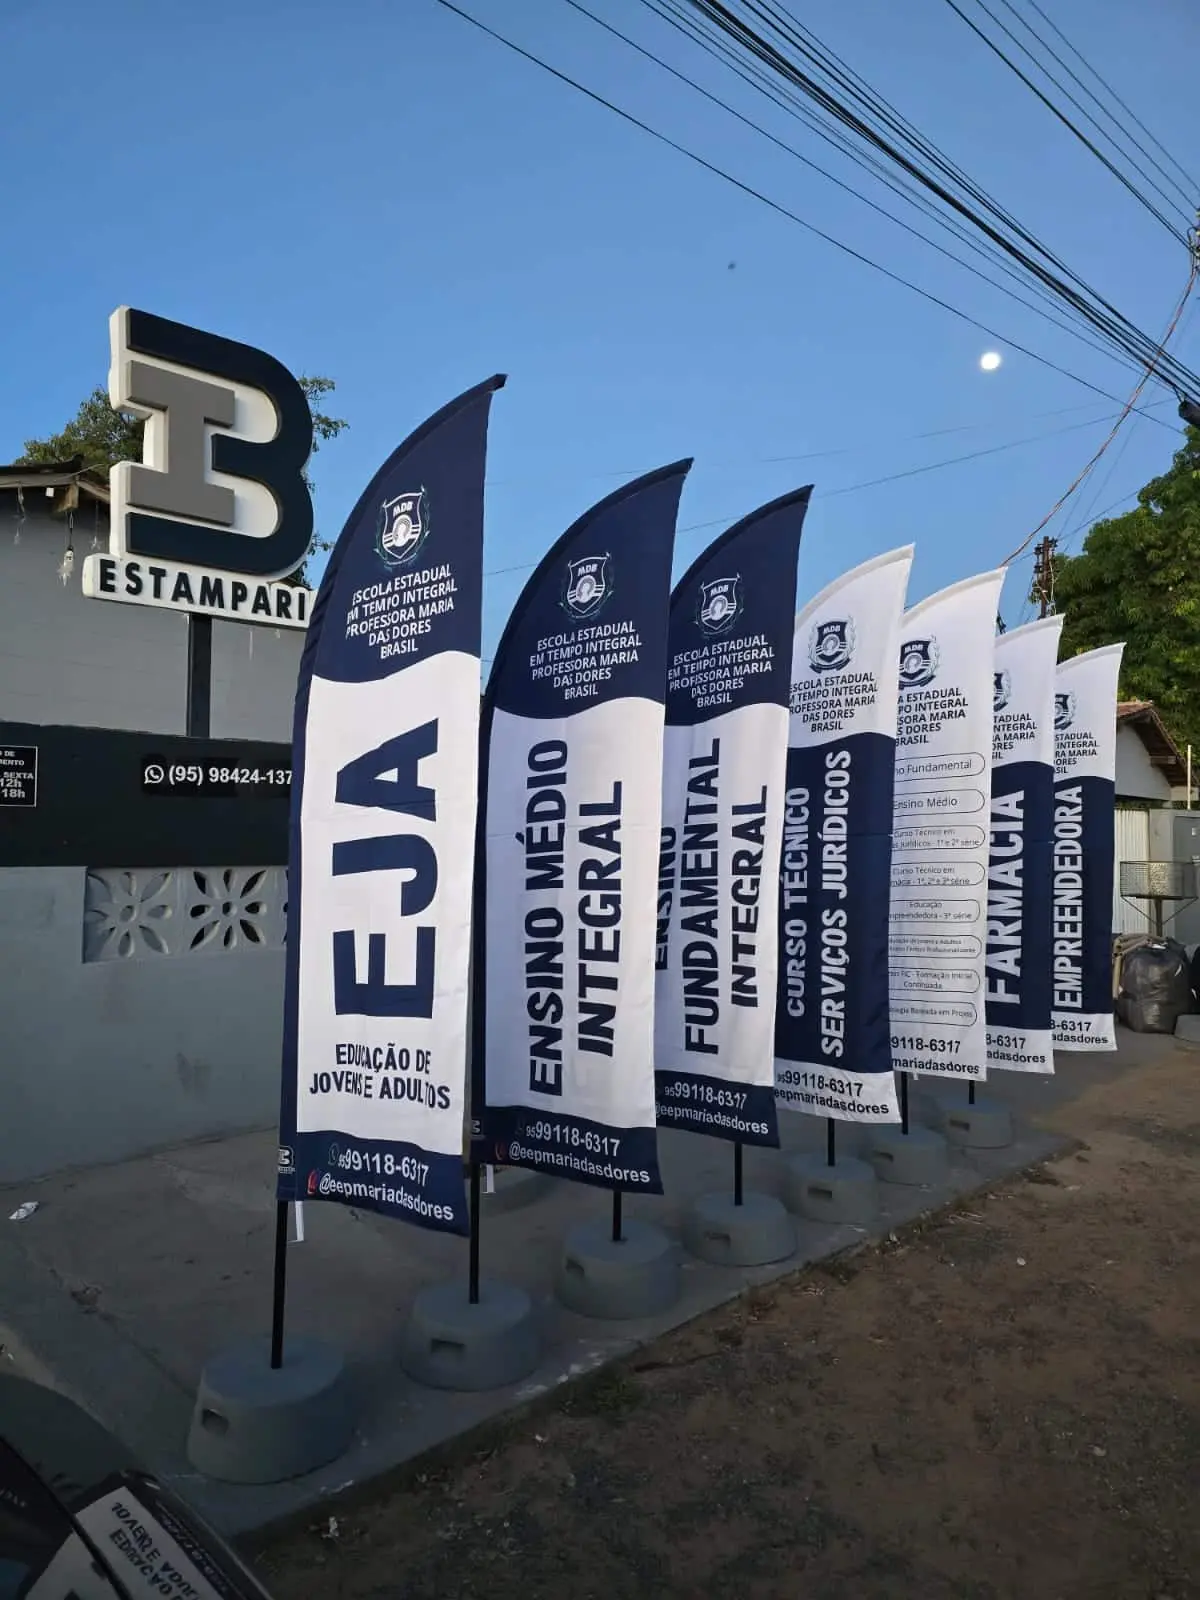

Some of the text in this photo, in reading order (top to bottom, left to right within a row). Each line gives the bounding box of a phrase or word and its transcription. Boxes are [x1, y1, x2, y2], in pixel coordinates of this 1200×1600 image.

[394, 564, 452, 591] ESTADUAL
[402, 578, 458, 604] INTEGRAL
[419, 596, 455, 619] MARIA
[392, 620, 431, 639] DORES
[537, 620, 636, 652] ESCOLA ESTADUAL
[380, 640, 418, 660] BRASIL
[529, 634, 642, 667] EM TEMPO INTEGRAL
[673, 634, 768, 666] ESCOLA ESTADUAL
[718, 647, 775, 666] INTEGRAL
[532, 649, 639, 681] PROFESSORA MARIA
[733, 661, 772, 677] MARIA
[553, 667, 612, 688] DAS DORES
[824, 672, 875, 686] ESTADUAL
[564, 683, 599, 700] BRASIL
[691, 677, 744, 699] DAS DORES
[797, 689, 829, 702] TEMPO
[831, 682, 879, 696] INTEGRAL
[906, 687, 962, 703] ESTADUAL
[697, 692, 733, 708] BRASIL
[844, 695, 876, 708] MARIA
[914, 697, 969, 713] INTEGRAL
[802, 708, 855, 723] DAS DORES
[929, 708, 966, 721] MARIA
[811, 720, 844, 732] BRASIL
[905, 722, 942, 735] DORES
[1003, 731, 1036, 742] MARIA
[1057, 740, 1099, 750] INTEGRAL
[1068, 748, 1097, 757] MARIA
[3, 772, 34, 780] SEXTA
[168, 765, 202, 786] (95)
[907, 759, 972, 774] Fundamental
[2, 788, 25, 798] 18h
[927, 797, 958, 808] Médio
[332, 718, 439, 1019] EJA
[680, 737, 720, 1055] FUNDAMENTAL
[731, 785, 767, 1008] INTEGRAL
[780, 787, 811, 1018] CURSO TÉCNICO
[817, 750, 851, 1058] SERVIÇOS JURÍDICOS
[1053, 785, 1083, 1009] EMPREENDEDORA
[515, 739, 569, 1097] ENSINO MÉDIO
[578, 781, 622, 1058] INTEGRAL
[335, 1042, 431, 1074] EDUCAÇÃO DE
[363, 1076, 373, 1098] E
[509, 1141, 650, 1183] @eepmariadasdores
